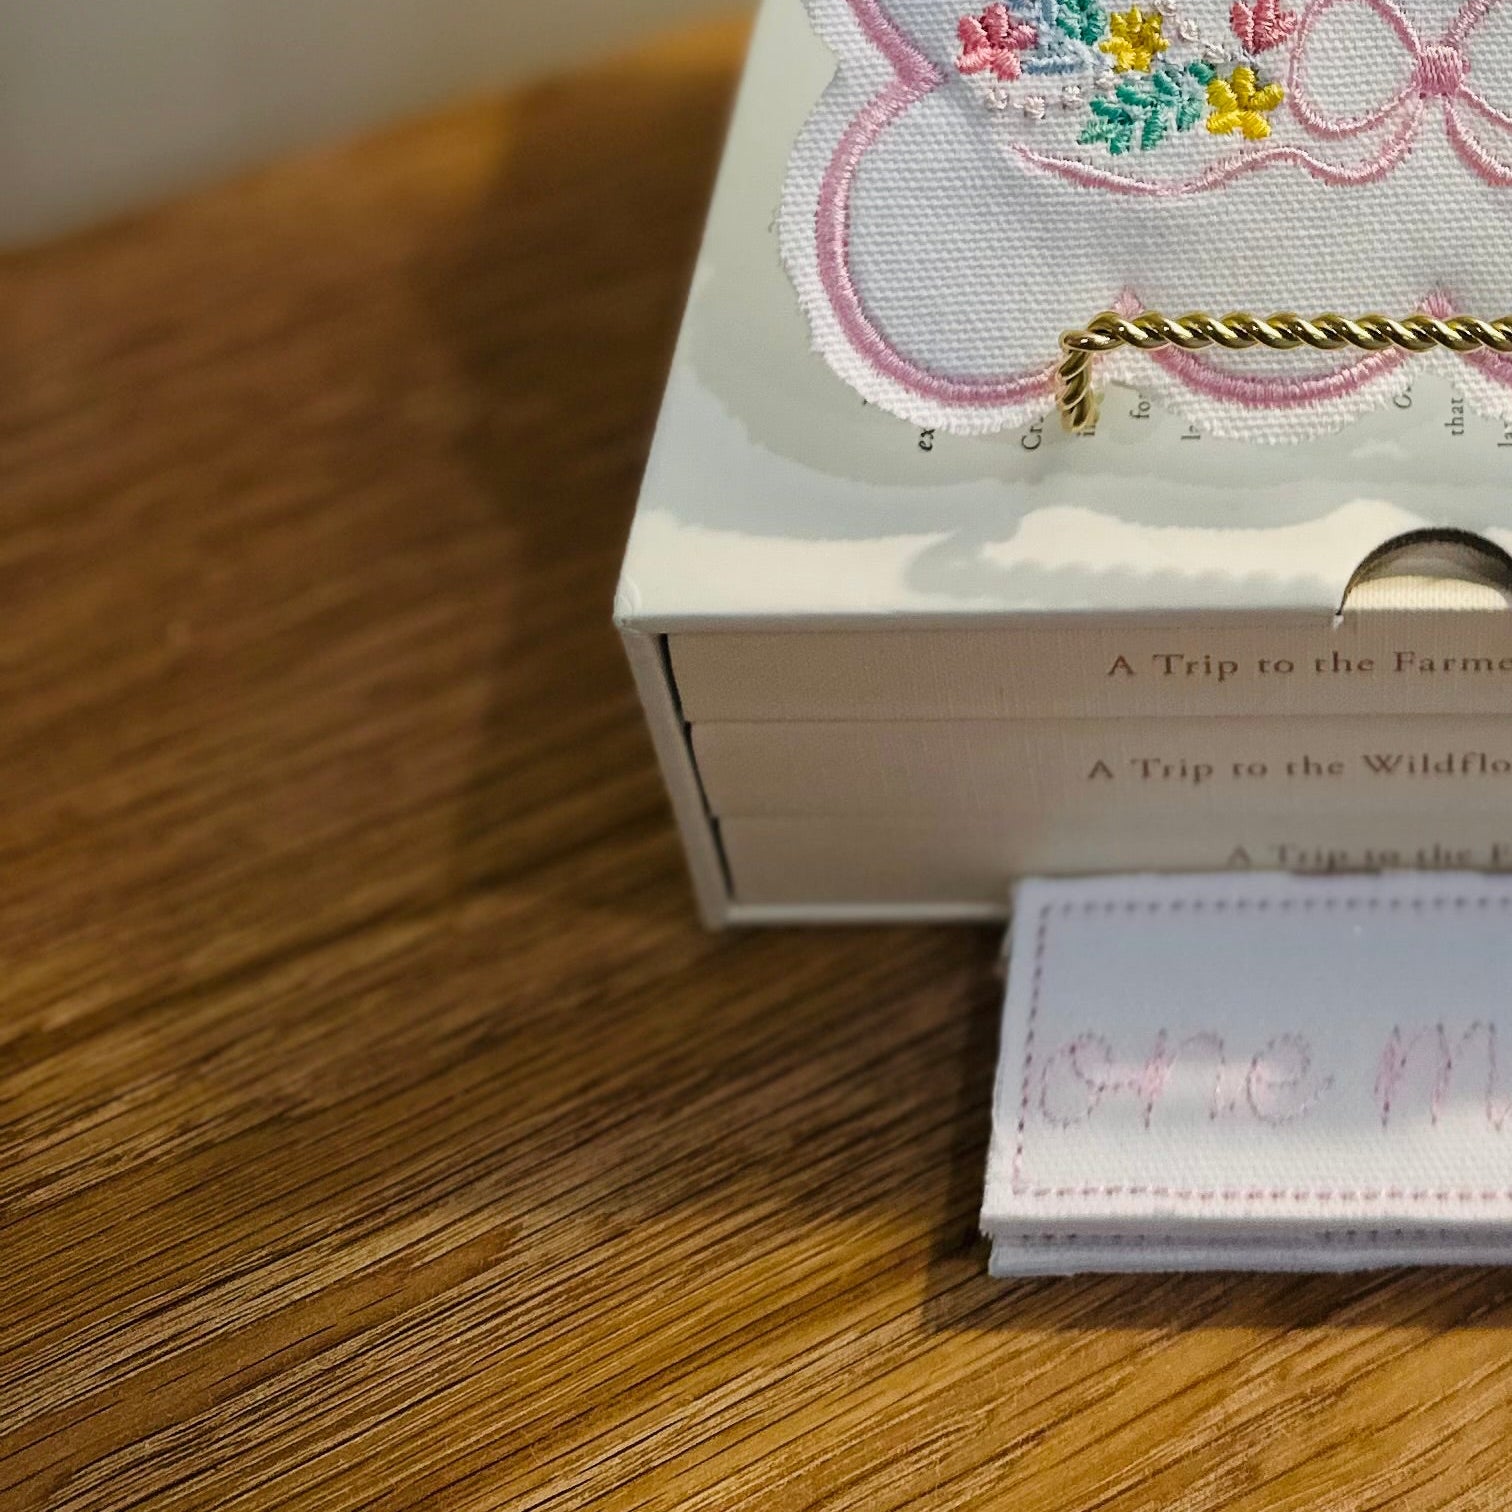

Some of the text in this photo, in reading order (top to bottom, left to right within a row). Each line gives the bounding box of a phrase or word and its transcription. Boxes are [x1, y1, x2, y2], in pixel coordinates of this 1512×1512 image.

[1106, 655, 1135, 677] A
[1153, 653, 1240, 682] Trip
[1258, 655, 1296, 675] to
[1314, 651, 1375, 674] the
[1087, 758, 1114, 781] A
[1130, 757, 1214, 786] Trip
[1232, 757, 1269, 778] to
[1286, 754, 1344, 778] the
[1037, 1028, 1335, 1128] one
